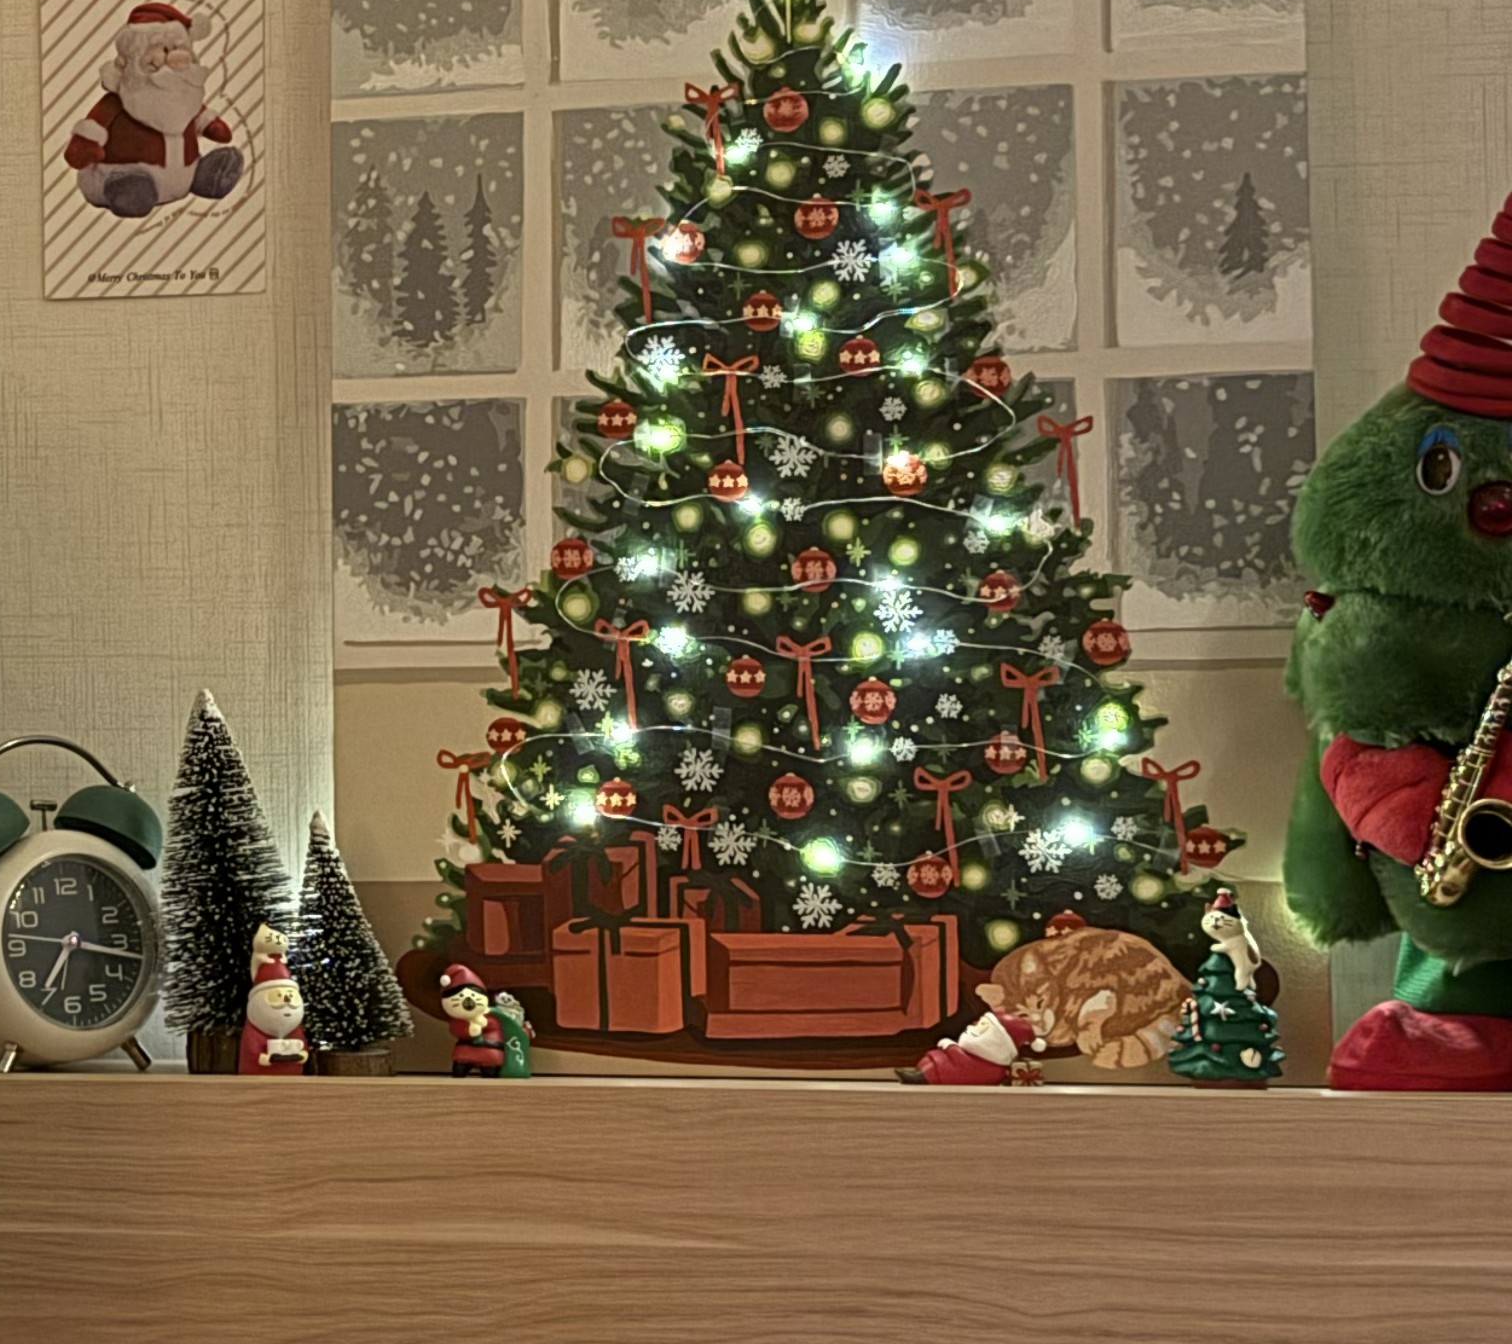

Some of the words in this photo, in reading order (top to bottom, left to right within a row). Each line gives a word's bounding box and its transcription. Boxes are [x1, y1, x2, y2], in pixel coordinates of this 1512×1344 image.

[53, 877, 78, 895] 12
[86, 884, 94, 901] 1
[32, 887, 45, 904] 11
[10, 910, 38, 928] 10
[102, 907, 118, 923] 2
[8, 940, 26, 957] 9
[19, 971, 36, 988] 8
[105, 964, 123, 980] 4
[89, 984, 107, 1002] 5
[64, 996, 81, 1014] 6
